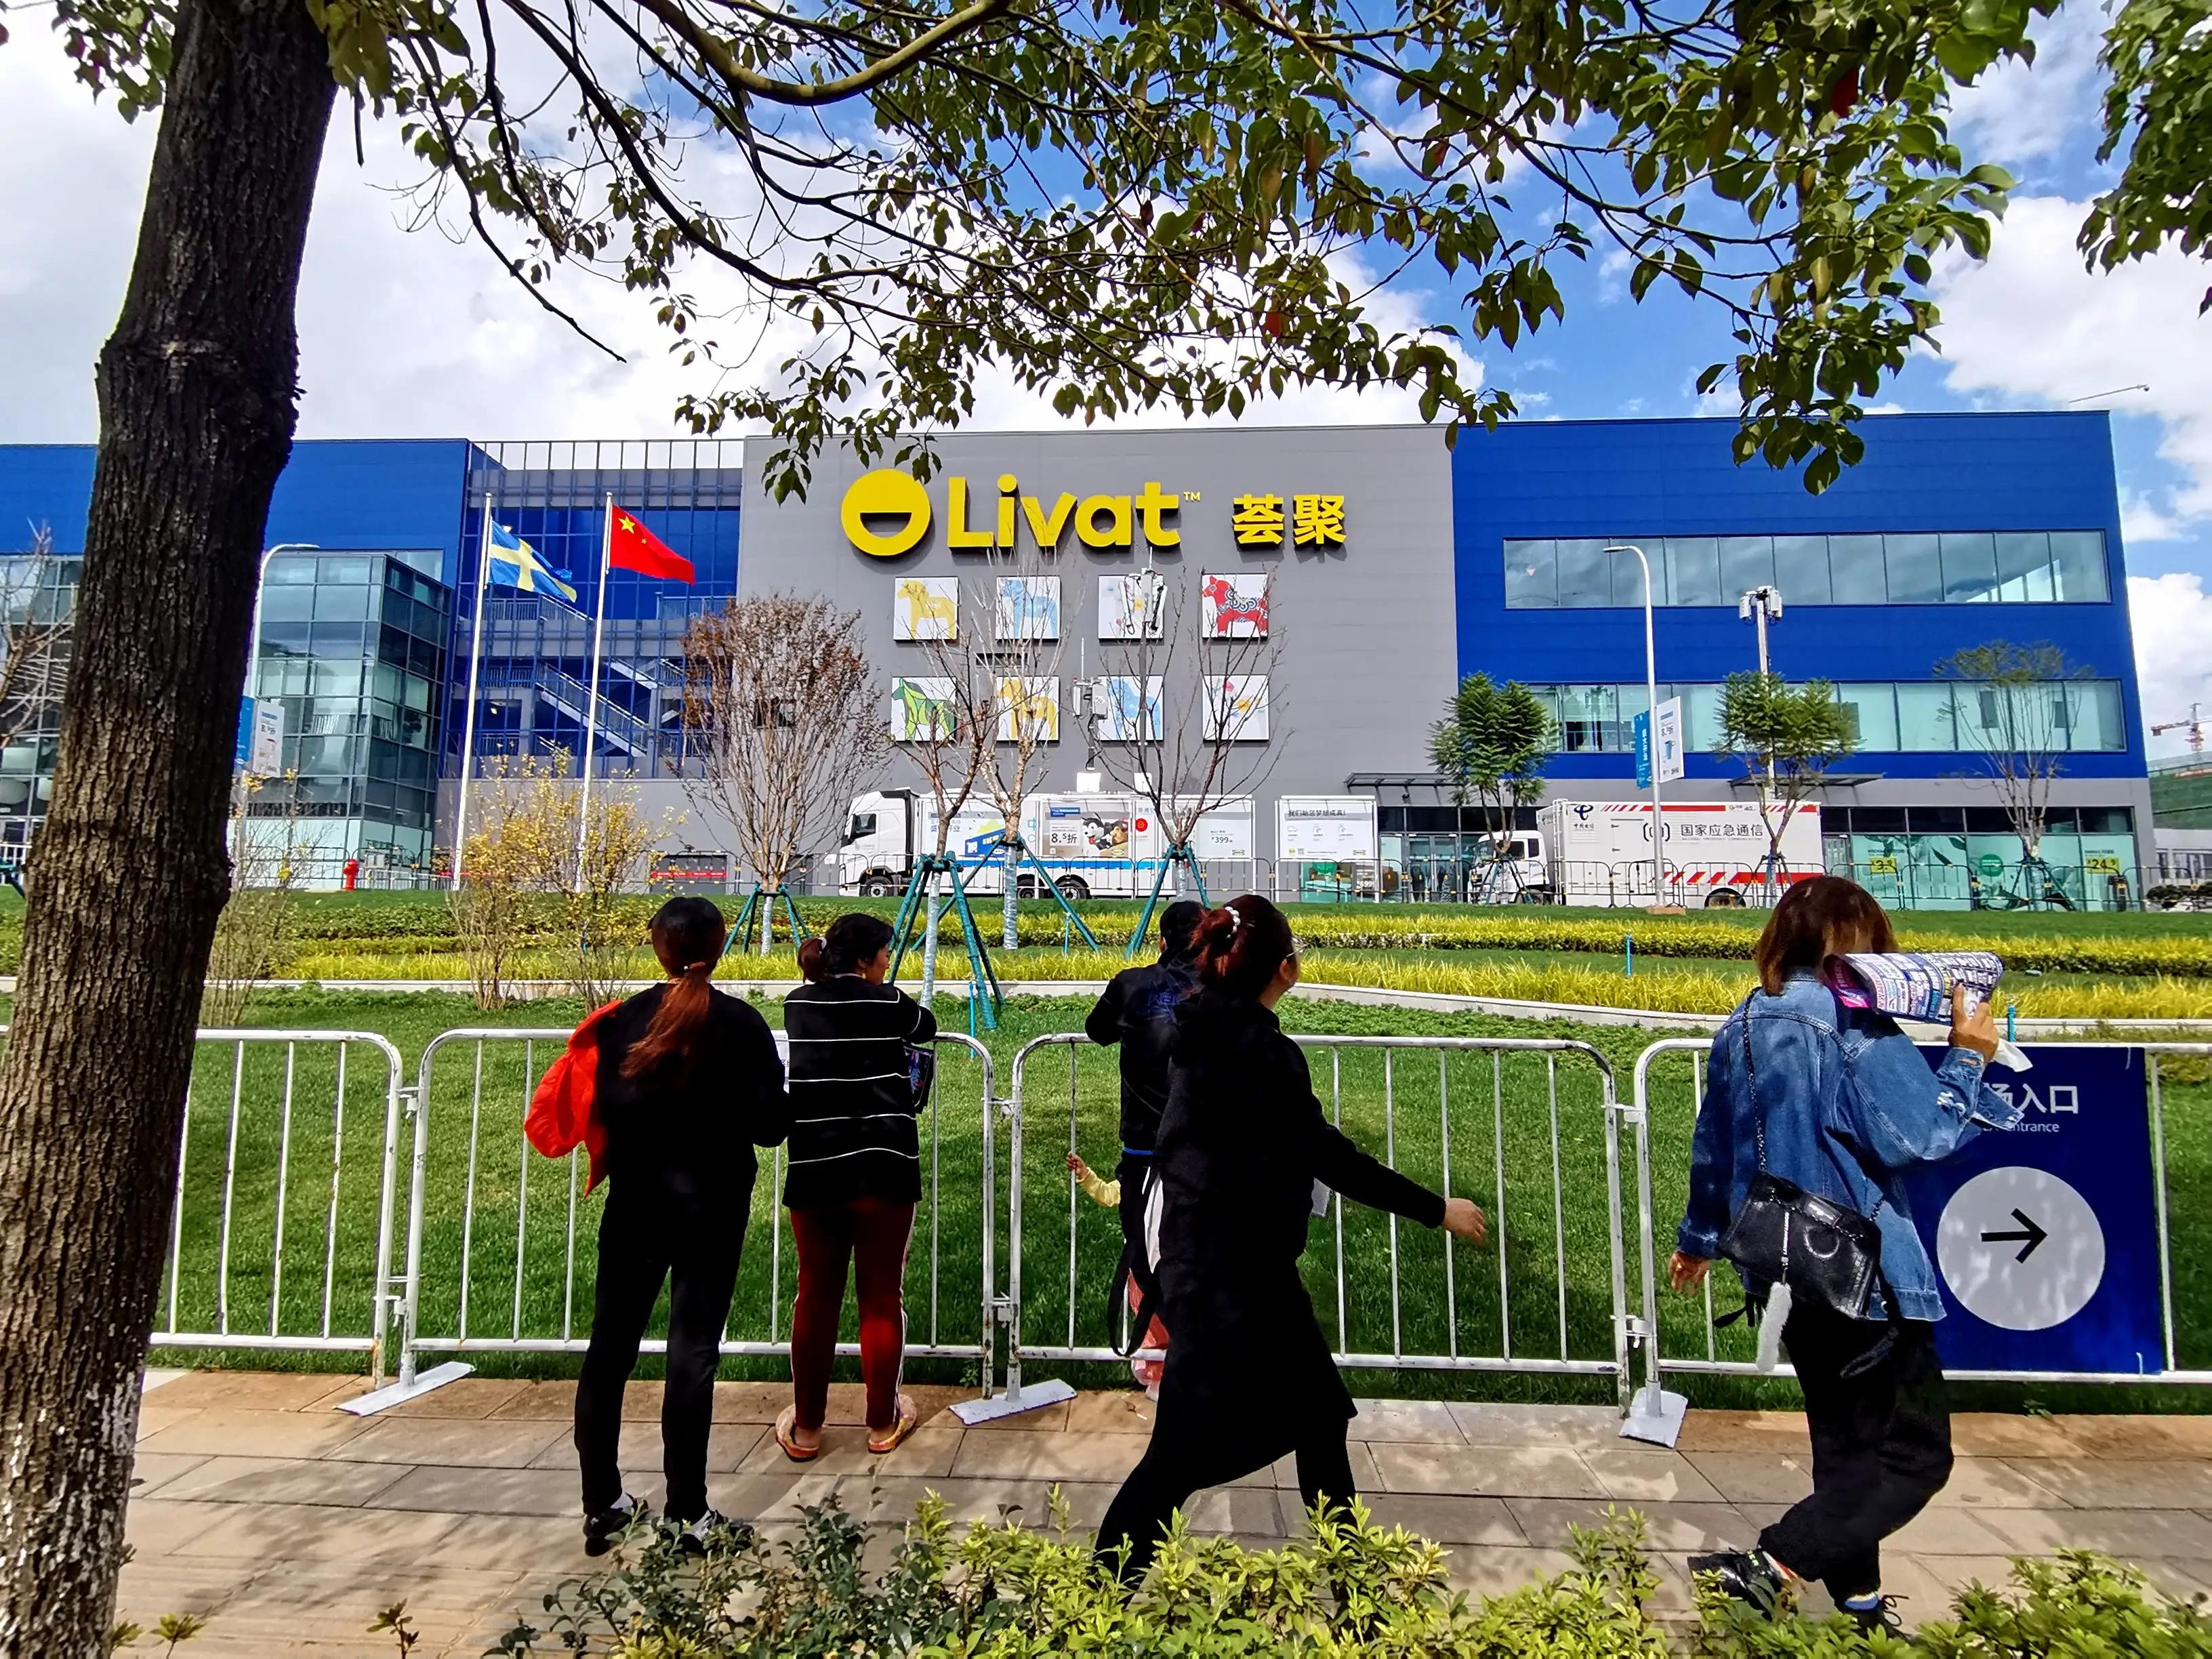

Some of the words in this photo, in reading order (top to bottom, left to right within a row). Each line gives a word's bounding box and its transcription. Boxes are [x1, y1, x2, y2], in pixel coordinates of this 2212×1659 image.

[947, 474, 1182, 548] Livat
[1233, 493, 1347, 546] 荟聚
[1681, 823, 1763, 837] 国家应急通信
[1051, 833, 1078, 844] 8.5折
[2007, 1122, 2060, 1132] ntrance
